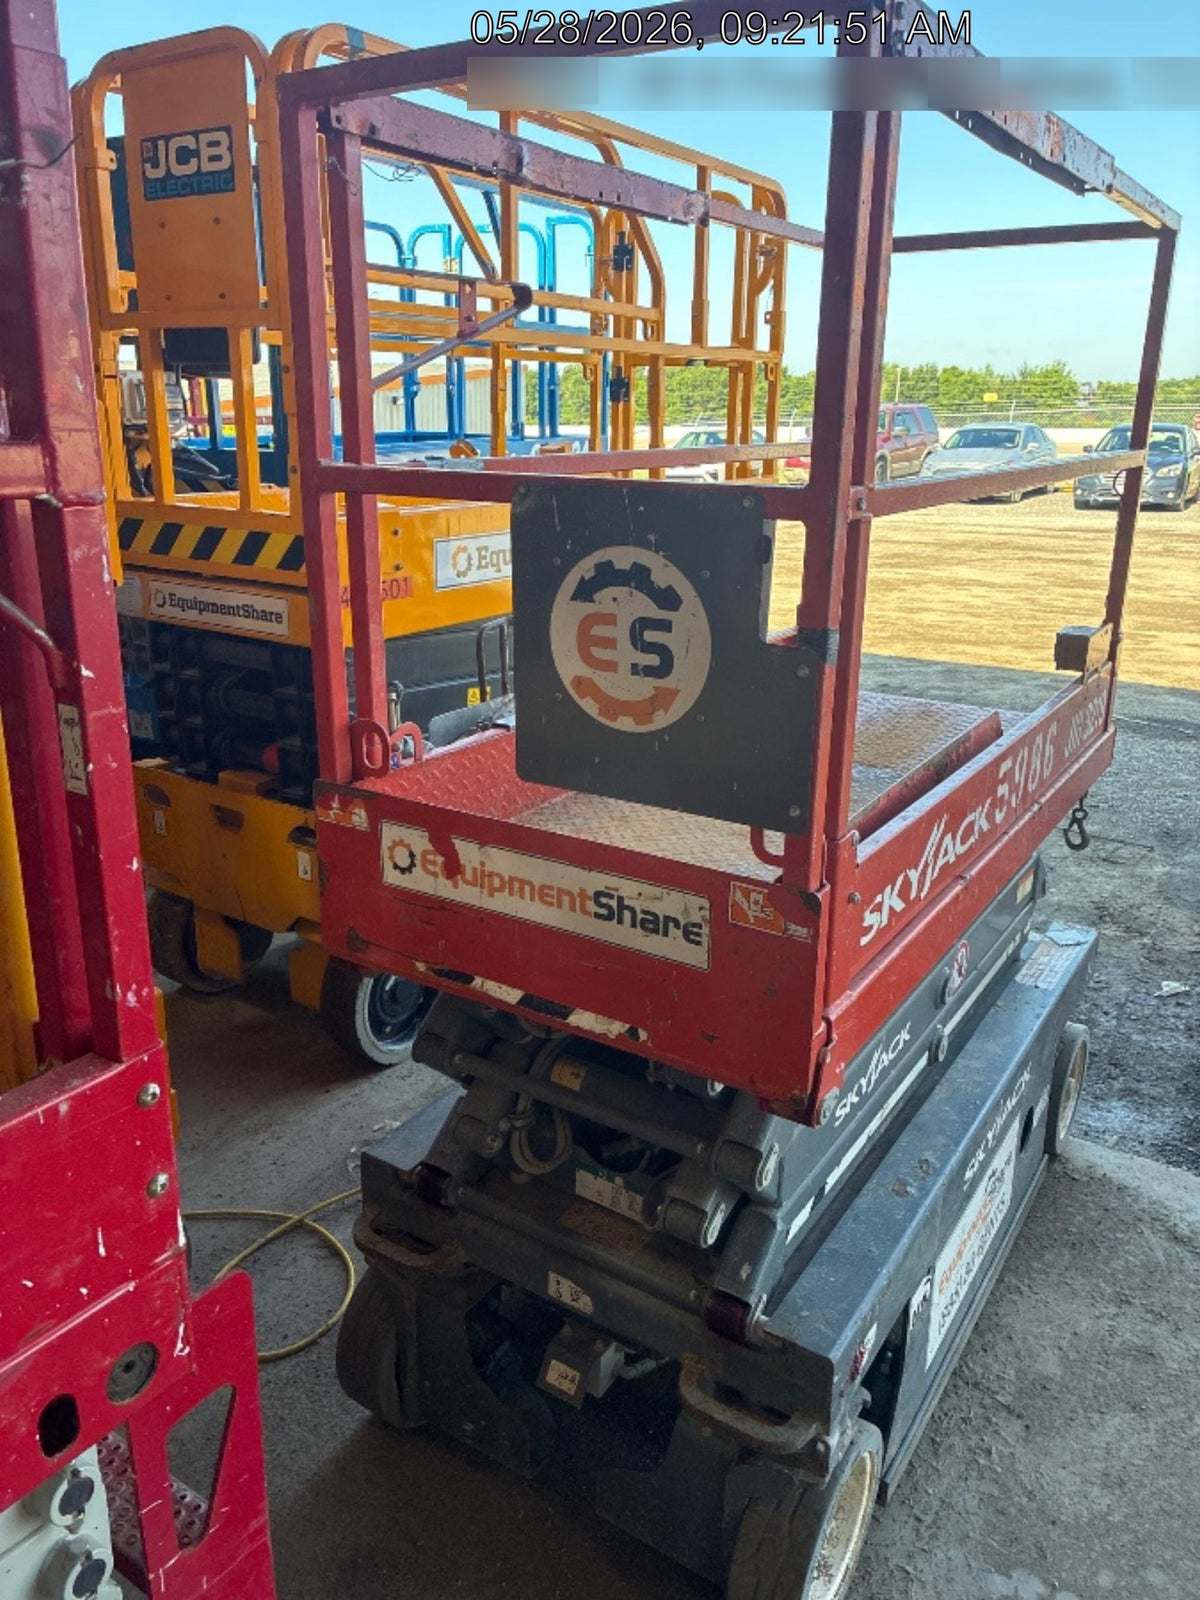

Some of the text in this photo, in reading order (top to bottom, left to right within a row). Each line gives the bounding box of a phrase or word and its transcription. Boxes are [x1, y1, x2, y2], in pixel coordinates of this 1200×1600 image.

[144, 131, 232, 179] JCB
[146, 172, 233, 198] ELECTRIC
[168, 592, 283, 624] EquipmentShare
[576, 612, 675, 679] ES
[860, 797, 992, 946] SKYJACK
[834, 1021, 911, 1127] SKYJACK
